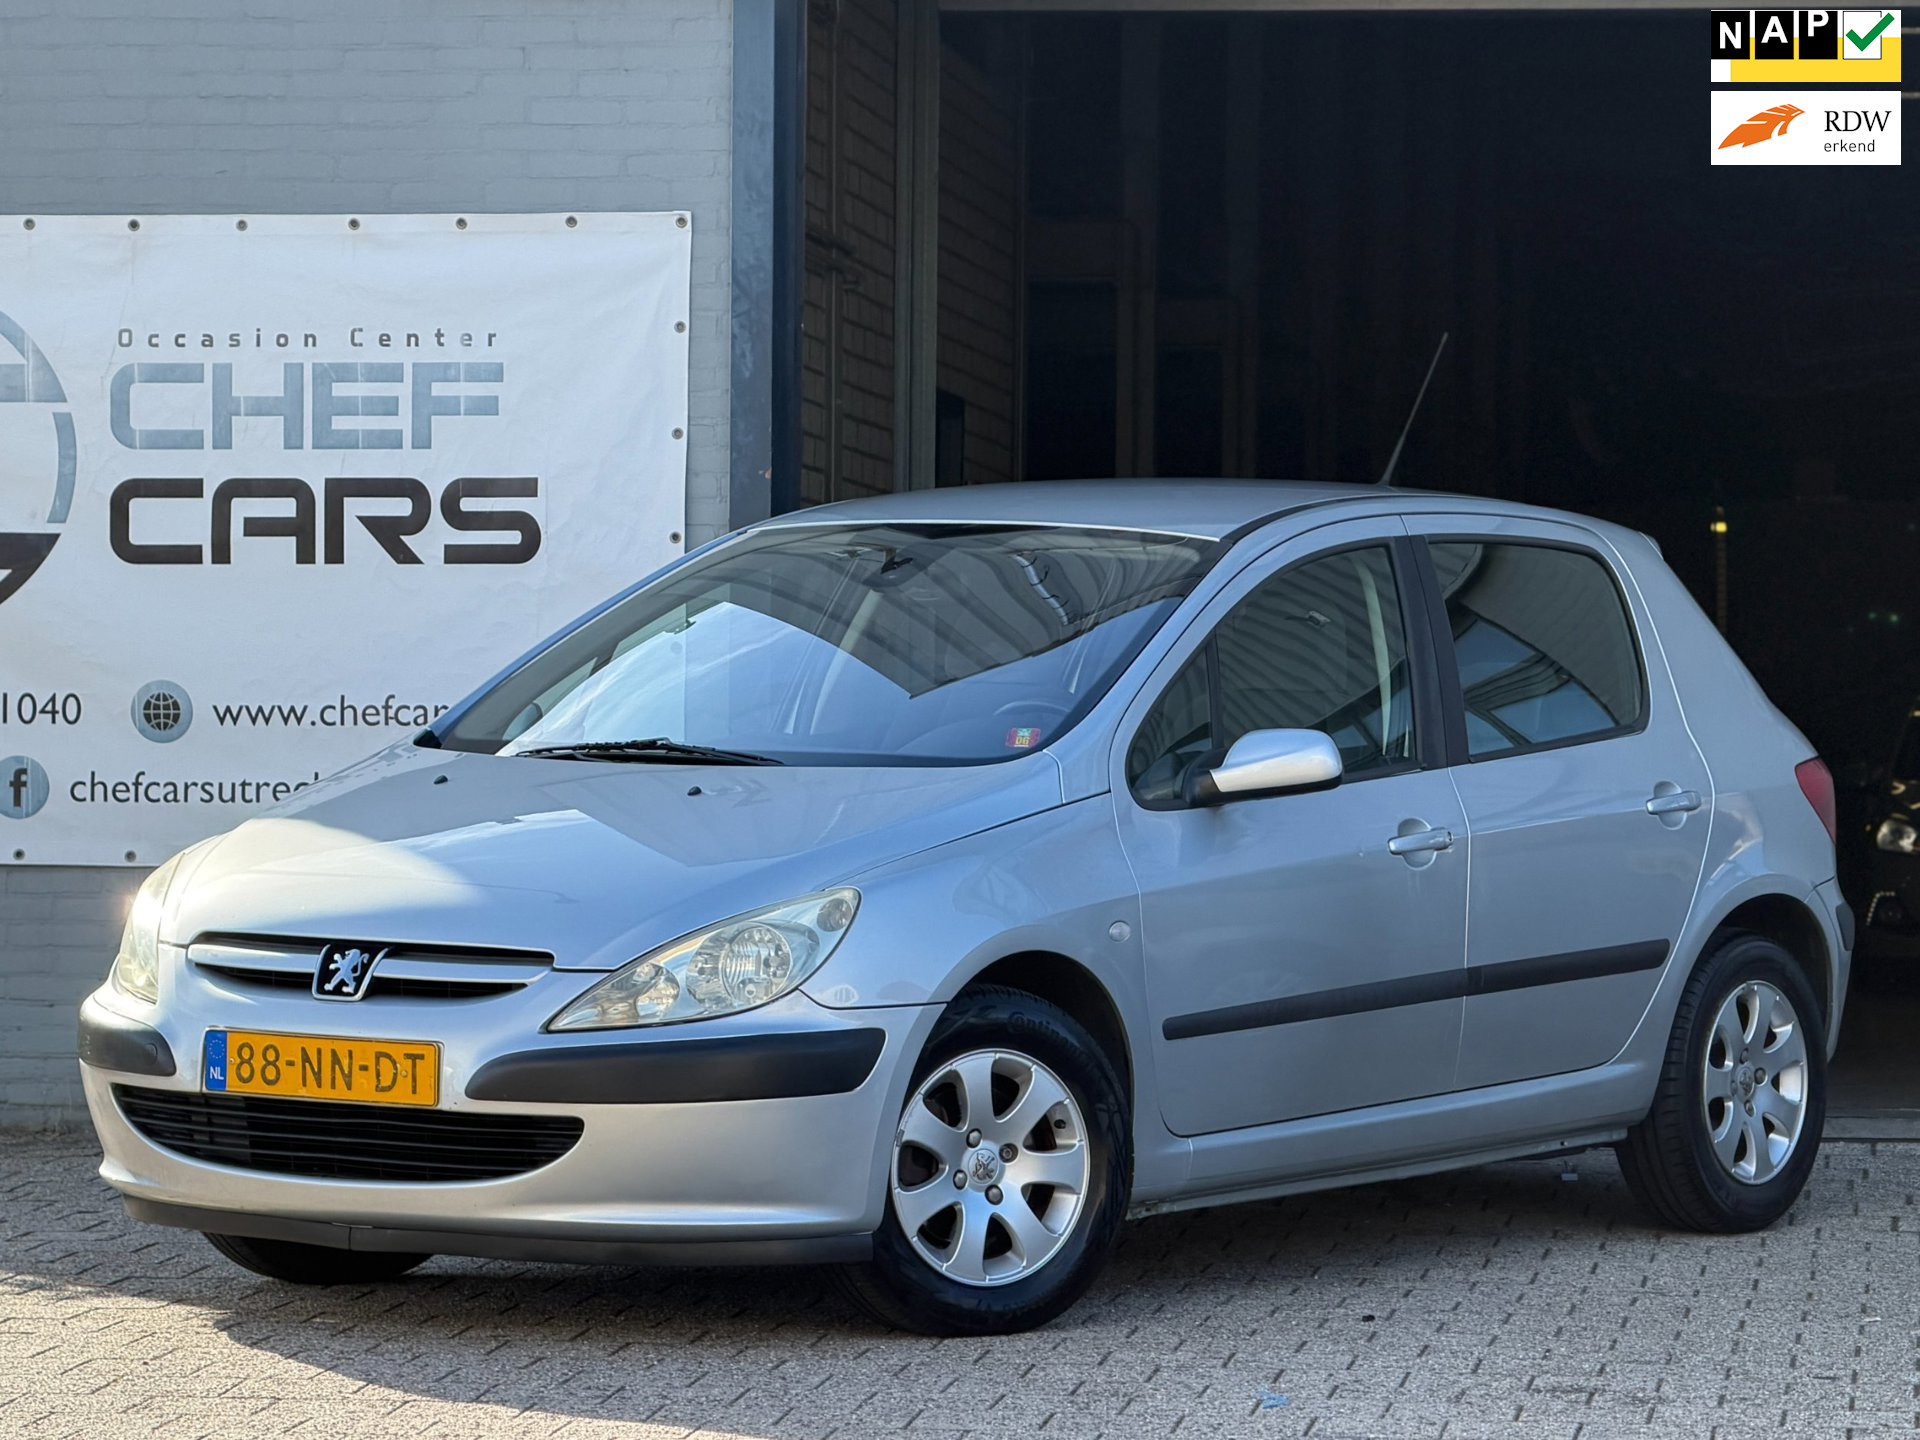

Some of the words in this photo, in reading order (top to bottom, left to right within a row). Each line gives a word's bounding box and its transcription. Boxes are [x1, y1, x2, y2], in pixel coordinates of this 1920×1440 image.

[117, 327, 317, 349] Occasion
[350, 327, 497, 348] Center
[109, 361, 504, 450] CHEF
[109, 477, 542, 564] CARS
[2, 692, 82, 725] 1040
[69, 770, 319, 804] chefcarsutre
[209, 1066, 225, 1081] NL
[235, 1041, 425, 1095] 88-NN-DT
